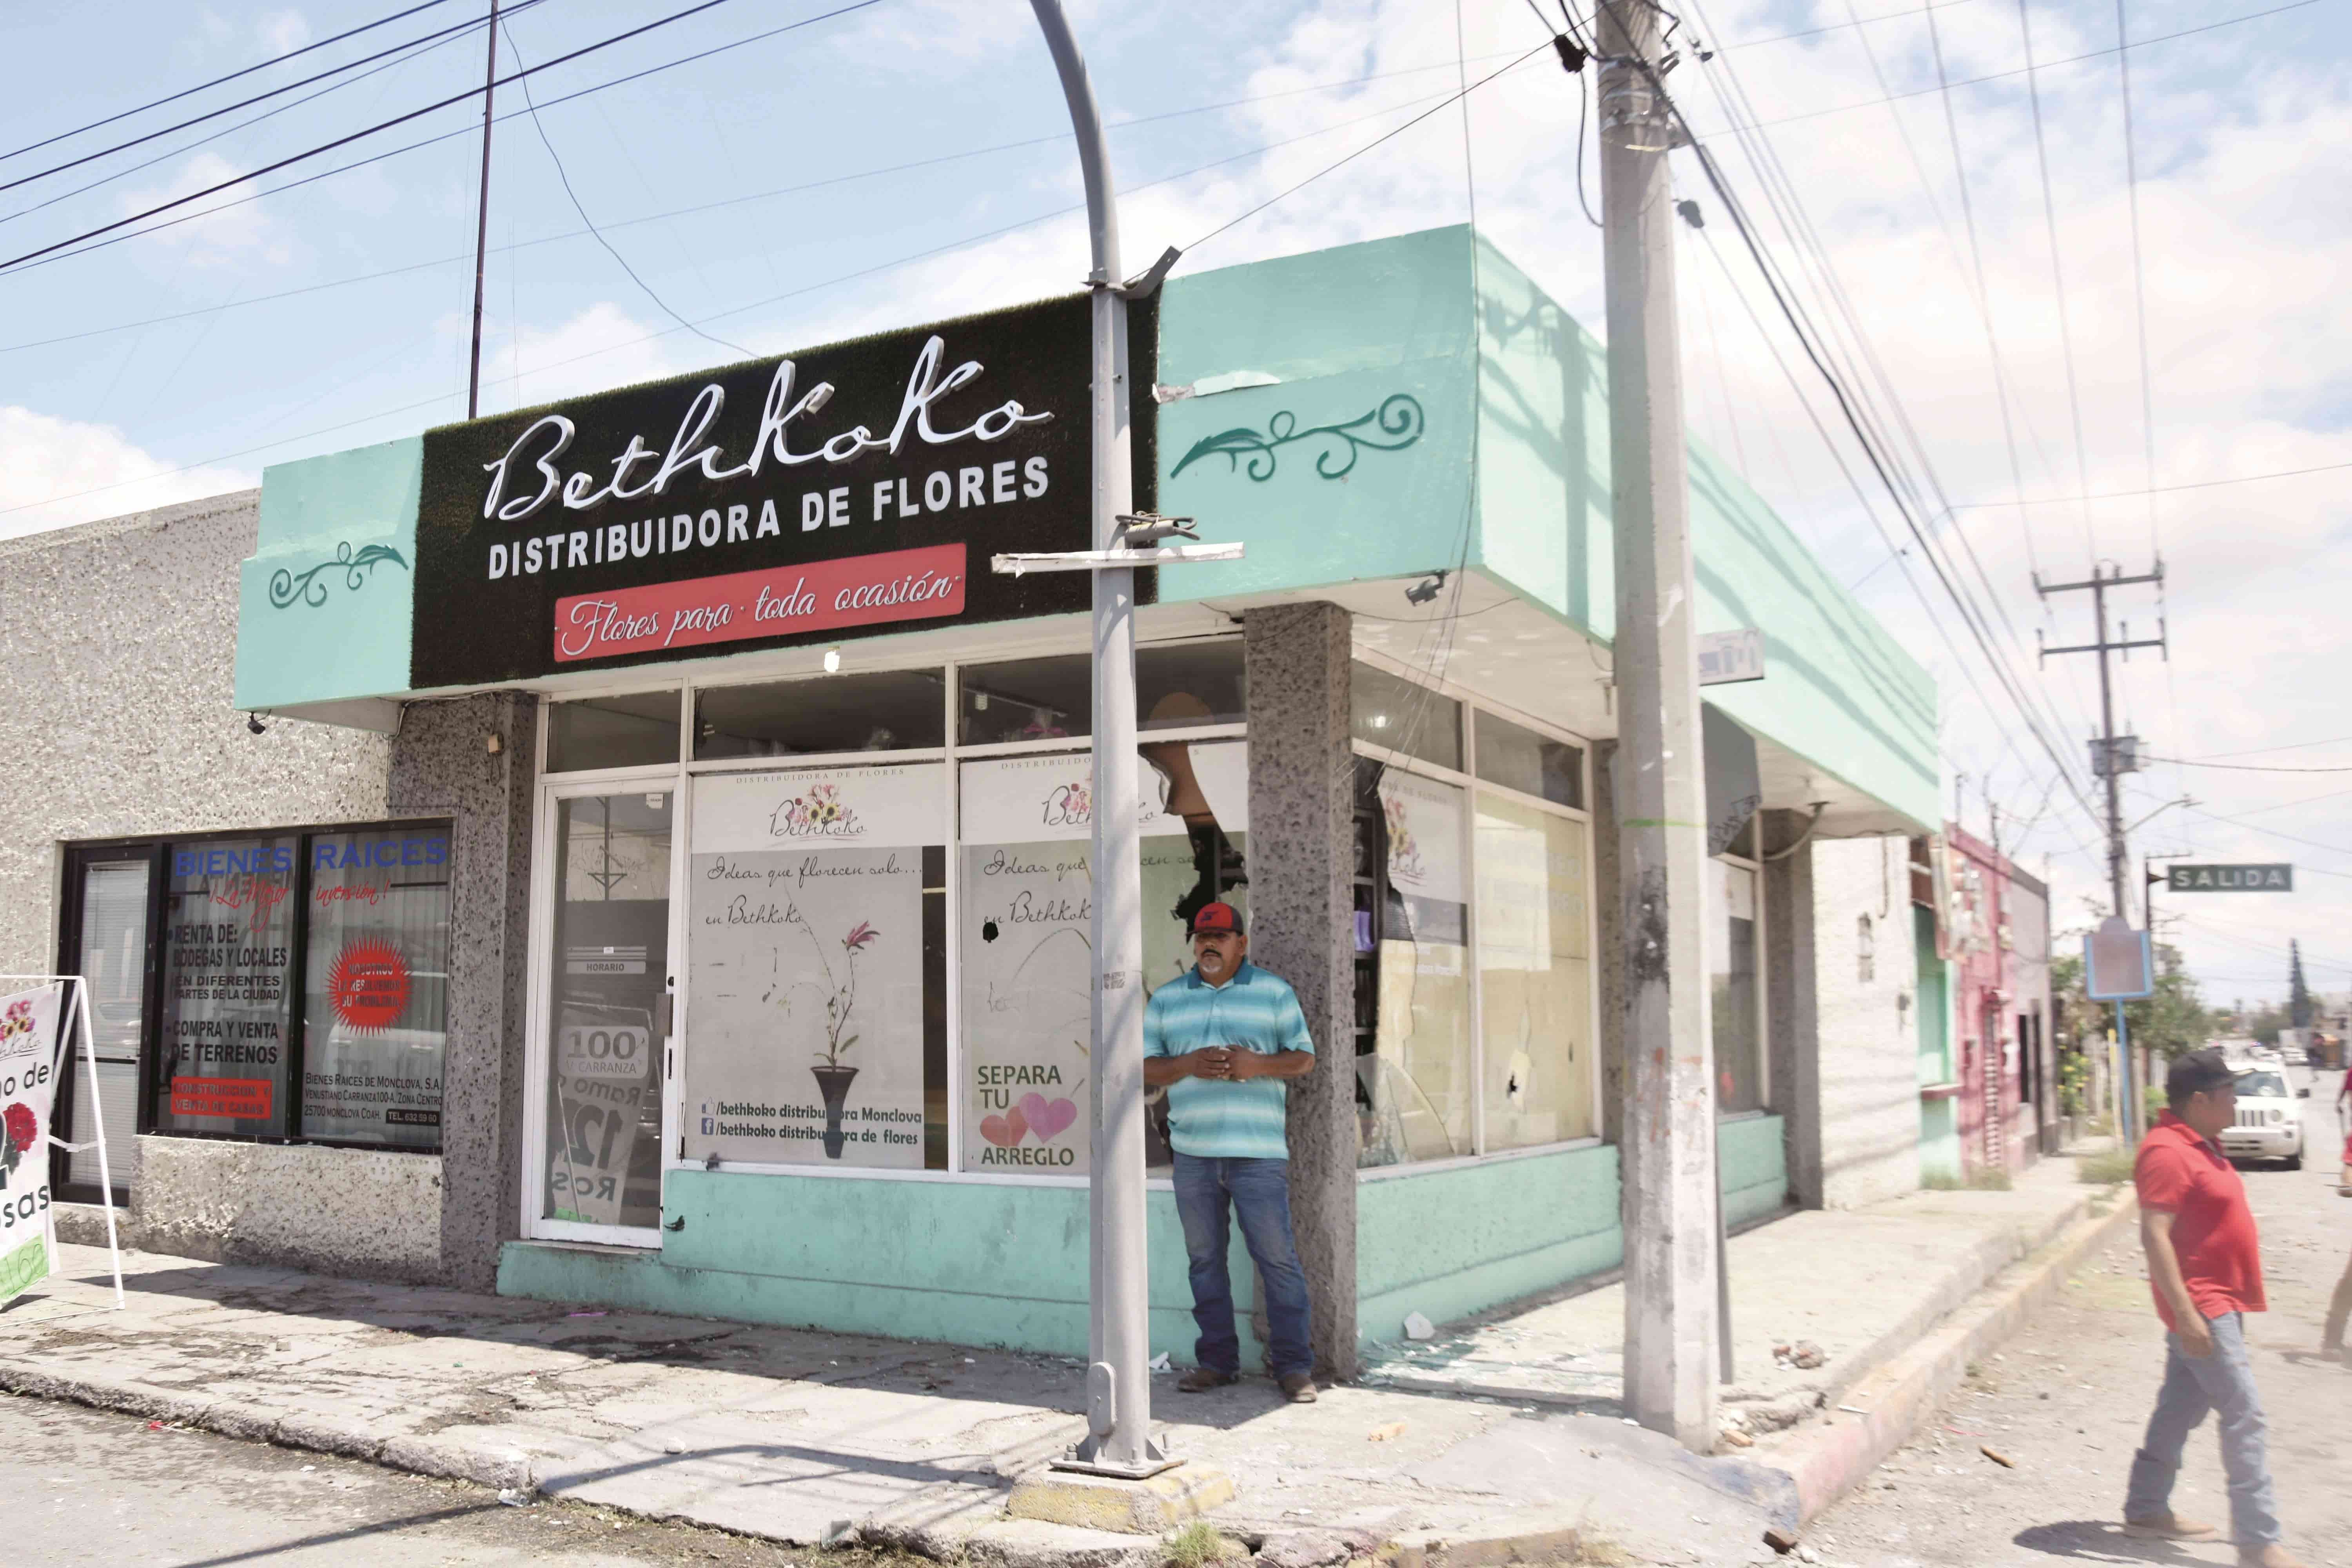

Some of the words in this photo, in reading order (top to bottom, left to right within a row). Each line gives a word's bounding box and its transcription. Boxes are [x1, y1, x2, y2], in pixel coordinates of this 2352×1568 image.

[489, 499, 780, 580] DISTRIBUIDORA
[802, 486, 850, 532] DE
[873, 456, 1049, 521] FLORES
[561, 599, 659, 656] Flores
[664, 603, 733, 646] para
[755, 577, 816, 622] toda
[834, 570, 953, 611] ocasión
[1001, 758, 1092, 769] DISTRIBUIDO
[736, 773, 829, 784] DISTRIBUIDORA
[859, 768, 904, 777] FLORES
[176, 847, 291, 877] BIENES
[315, 838, 447, 870] RAICES
[983, 849, 1049, 875] Ideas
[707, 856, 763, 879] Ideas
[768, 868, 793, 888] que
[798, 856, 863, 889] florecen
[2174, 869, 2286, 887] SALIDA
[241, 875, 289, 933] Mejor
[706, 915, 722, 924] en
[984, 916, 1005, 924] en
[175, 924, 214, 944] RENTA
[218, 924, 238, 944] DE:
[173, 948, 223, 967] BODEGAS
[227, 948, 234, 967] Y
[237, 947, 287, 967] LOCALES
[348, 963, 393, 976] NOSOTROS
[586, 963, 624, 972] HORARIO
[177, 975, 192, 986] EN
[196, 975, 280, 987] DIFERENTES
[175, 989, 209, 1000] PARTES
[212, 989, 226, 1000] DE
[228, 989, 240, 1000] LA
[243, 989, 280, 1000] CIUDAD
[174, 1020, 222, 1038] COMPRA
[226, 1021, 235, 1038] Y
[238, 1022, 278, 1038] VENTA
[170, 1043, 190, 1061] DE
[194, 1043, 278, 1065] TERRENOS
[567, 1030, 636, 1060] 100
[24, 1062, 49, 1089] de
[579, 1061, 637, 1074] CARRANZA
[978, 1065, 1062, 1085] SEPARA
[174, 1083, 257, 1098] CONSTRUCCION
[263, 1086, 270, 1098] Y
[306, 1073, 333, 1085] BIENES
[335, 1073, 363, 1087] RAICES
[365, 1077, 374, 1087] DE
[425, 1078, 442, 1091] S.A.
[305, 1088, 342, 1101] VENUSTIANO
[398, 1094, 415, 1105] ZONA
[417, 1093, 443, 1106] CENTRO
[979, 1089, 1009, 1110] TU
[175, 1098, 209, 1112] VENTA
[212, 1101, 226, 1113] DE
[229, 1102, 264, 1115] CASAS
[304, 1105, 325, 1117] 25700
[327, 1108, 359, 1119] MONCLOVA
[388, 1111, 404, 1122] TEL.
[716, 1101, 777, 1117] /bethkoko
[862, 1107, 922, 1123] Monclova
[716, 1122, 776, 1138] /bethkoko
[861, 1129, 877, 1143] de
[883, 1129, 918, 1145] flores
[981, 1147, 1074, 1166] ARREGLO
